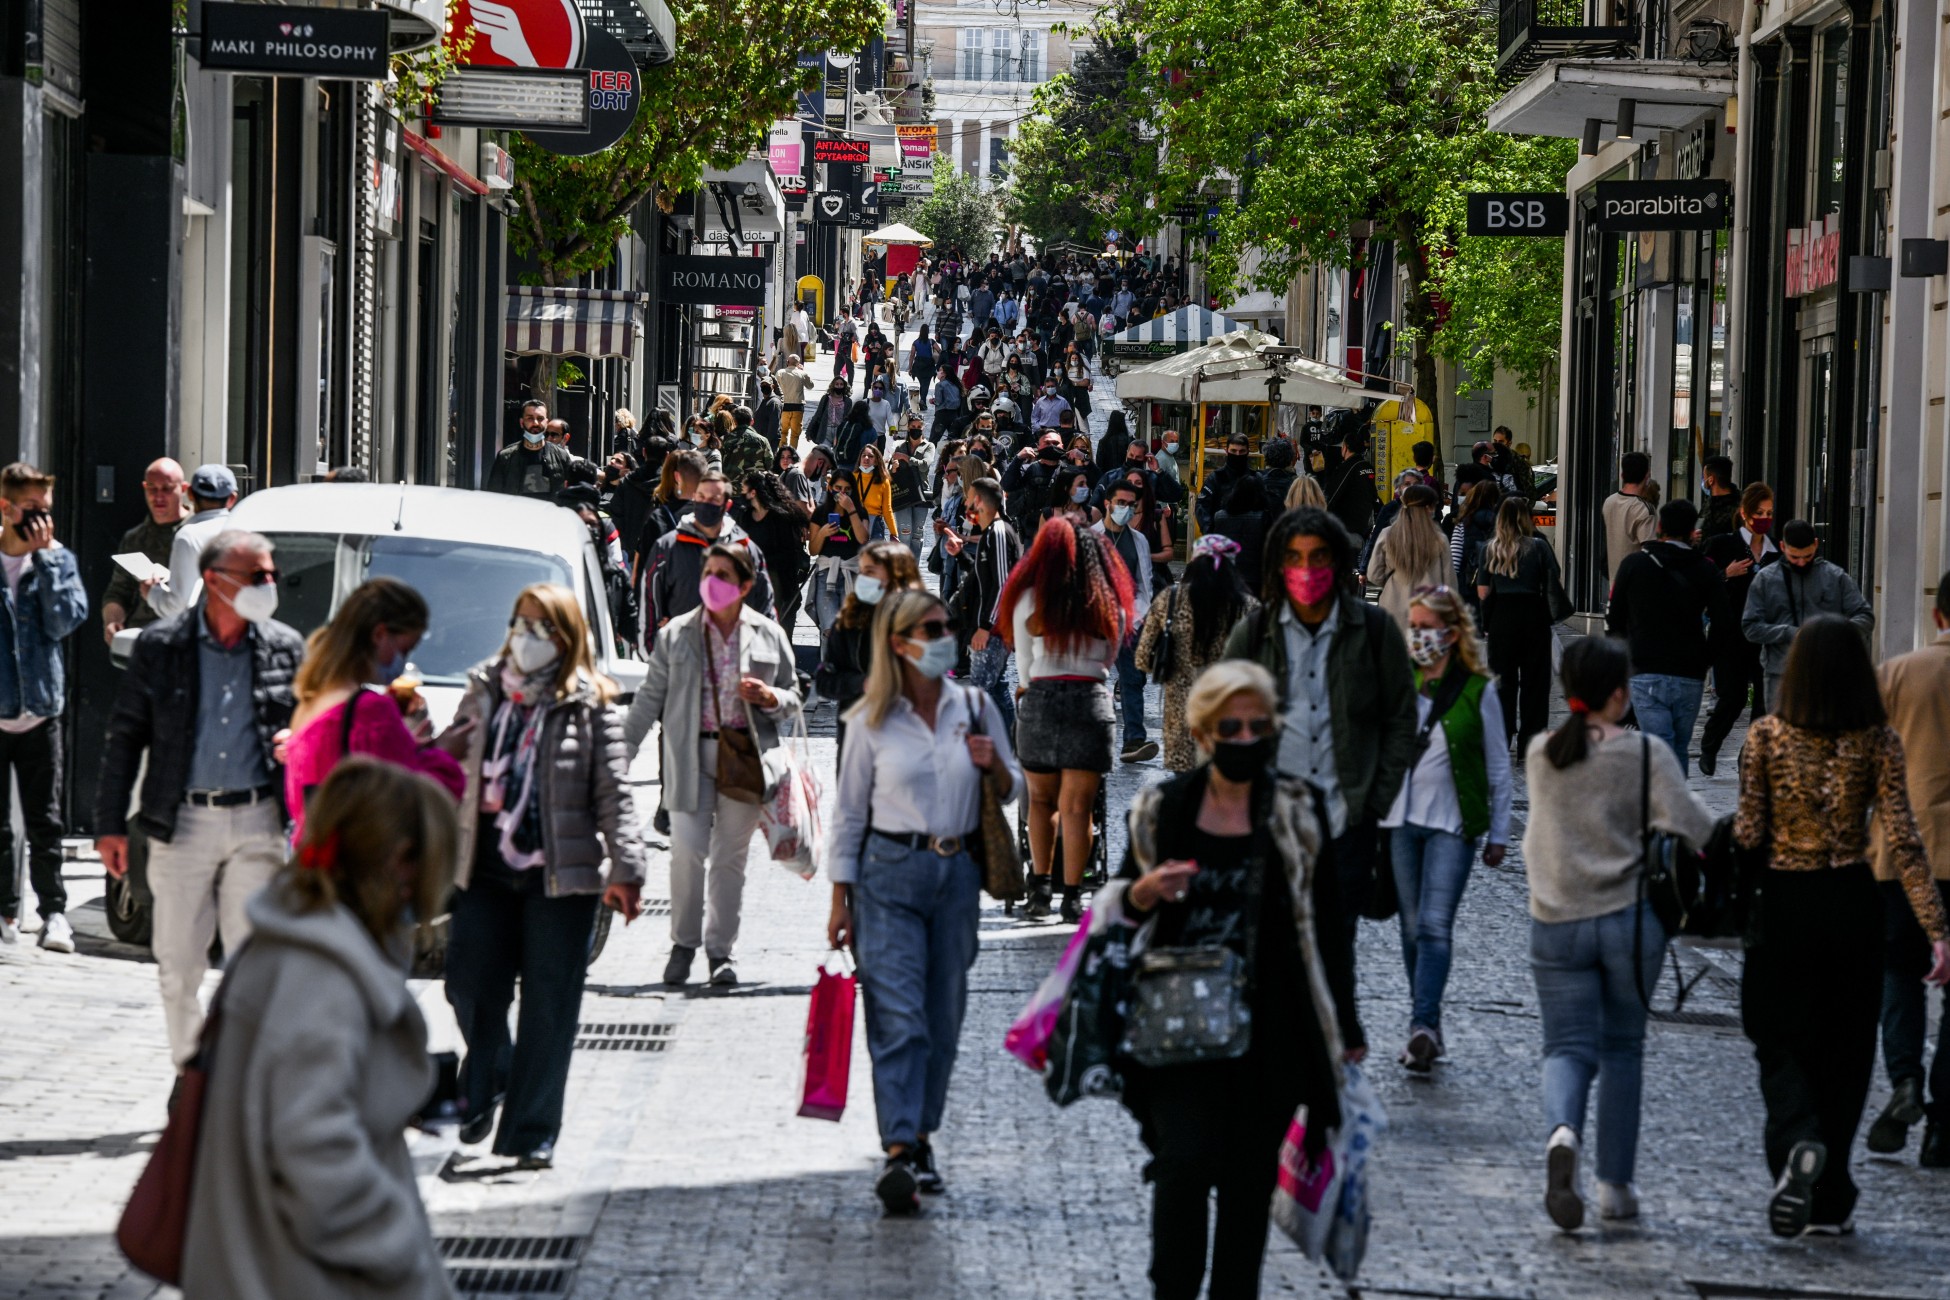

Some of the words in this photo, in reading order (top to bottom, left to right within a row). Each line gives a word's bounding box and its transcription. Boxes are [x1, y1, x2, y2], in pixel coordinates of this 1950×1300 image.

[210, 39, 256, 55] MAKI
[265, 41, 377, 61] PHILOSOPHY
[590, 90, 632, 110] ORT
[768, 148, 786, 158] LON
[815, 140, 869, 152] ΑΝΤΑΛΛΑΓΗ
[1487, 200, 1547, 228] BSB
[1605, 195, 1703, 219] parabita
[672, 271, 761, 290] ROMANO
[1114, 344, 1147, 352] ERMOU
[1147, 341, 1177, 353] Flower
